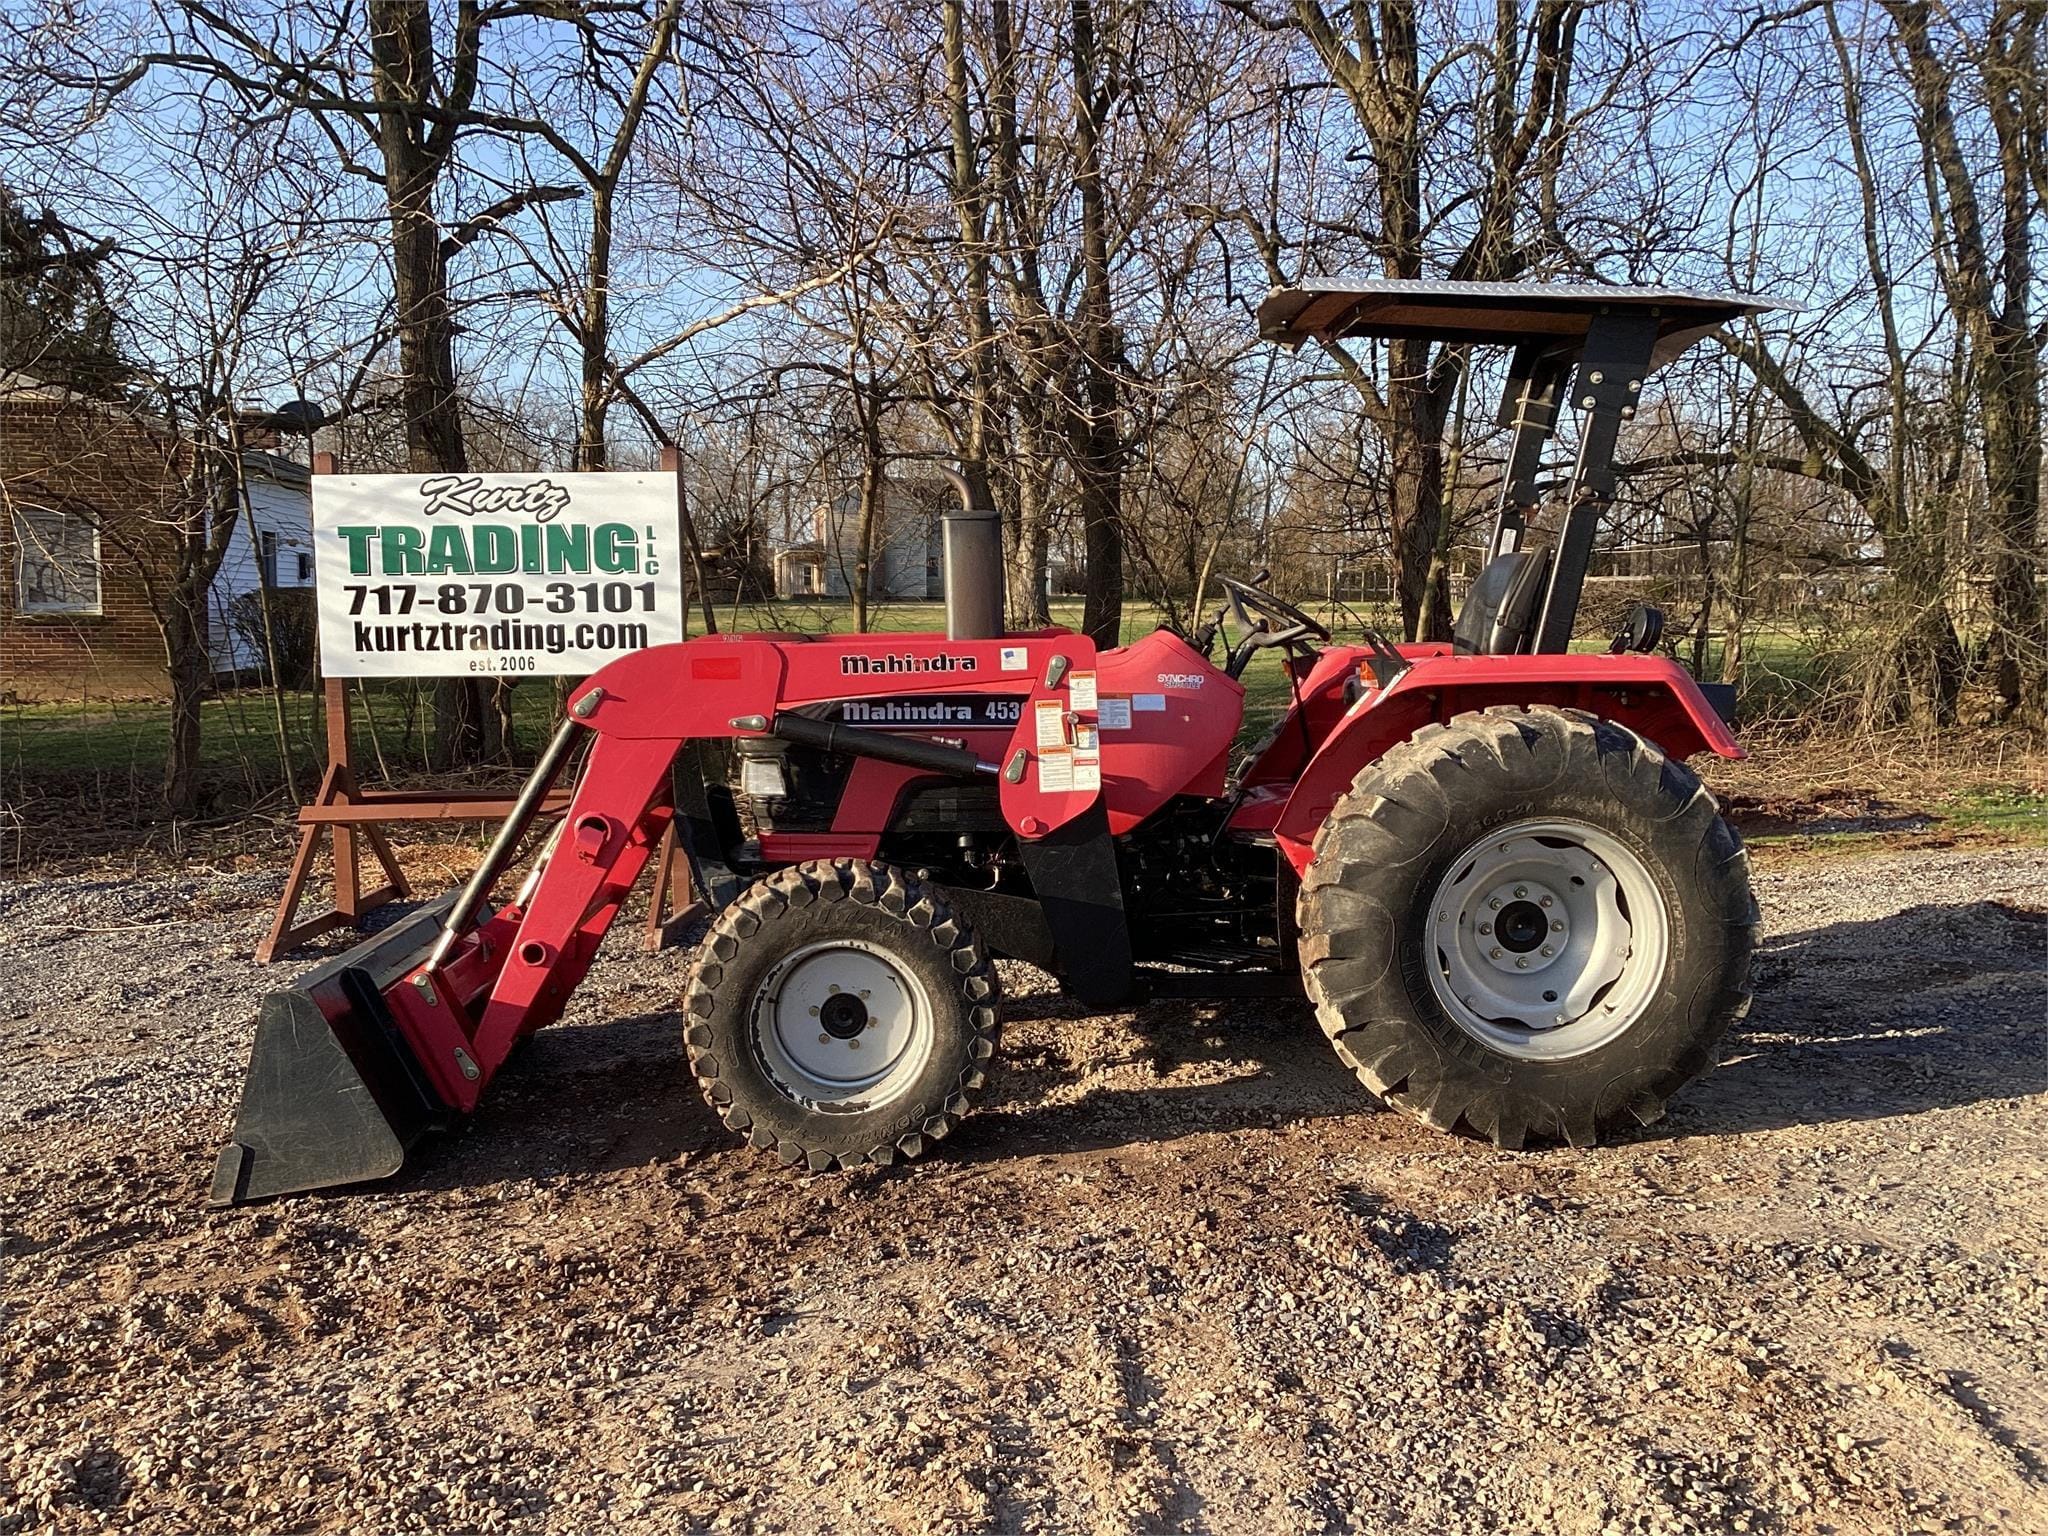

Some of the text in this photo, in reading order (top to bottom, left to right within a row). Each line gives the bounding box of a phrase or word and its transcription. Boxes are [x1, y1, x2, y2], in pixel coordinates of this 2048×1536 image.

[420, 476, 571, 523] Kurtz
[337, 523, 640, 576] TRADING
[646, 525, 659, 576] LLC
[343, 582, 656, 616] 717-870-3101
[354, 619, 648, 653] kurtztrading.com
[469, 656, 535, 671] est. 2006
[841, 653, 977, 675] Mahindra
[1157, 674, 1204, 684] SYNCHRO
[842, 702, 972, 721] Mahindra
